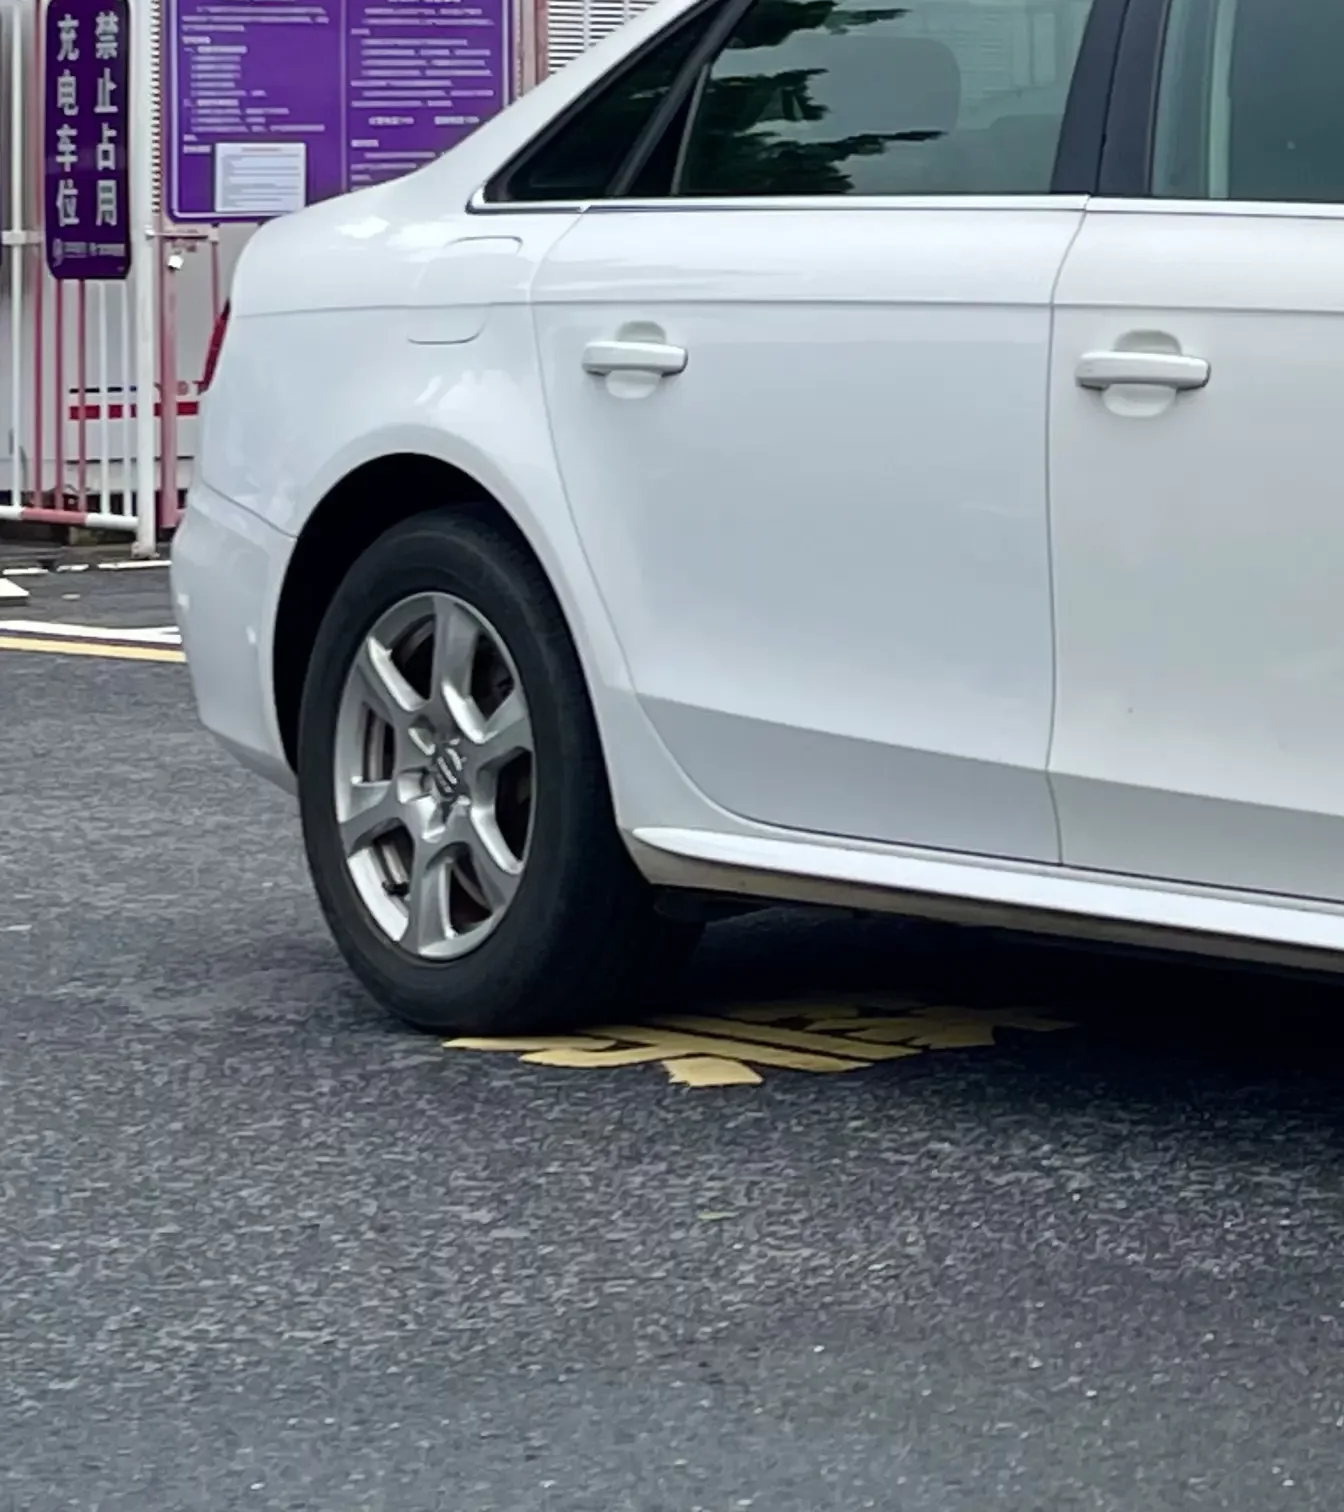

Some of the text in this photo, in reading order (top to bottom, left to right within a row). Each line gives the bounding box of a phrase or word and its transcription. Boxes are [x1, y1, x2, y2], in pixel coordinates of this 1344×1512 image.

[56, 14, 80, 228] 充电车位
[94, 11, 119, 227] 禁止占用
